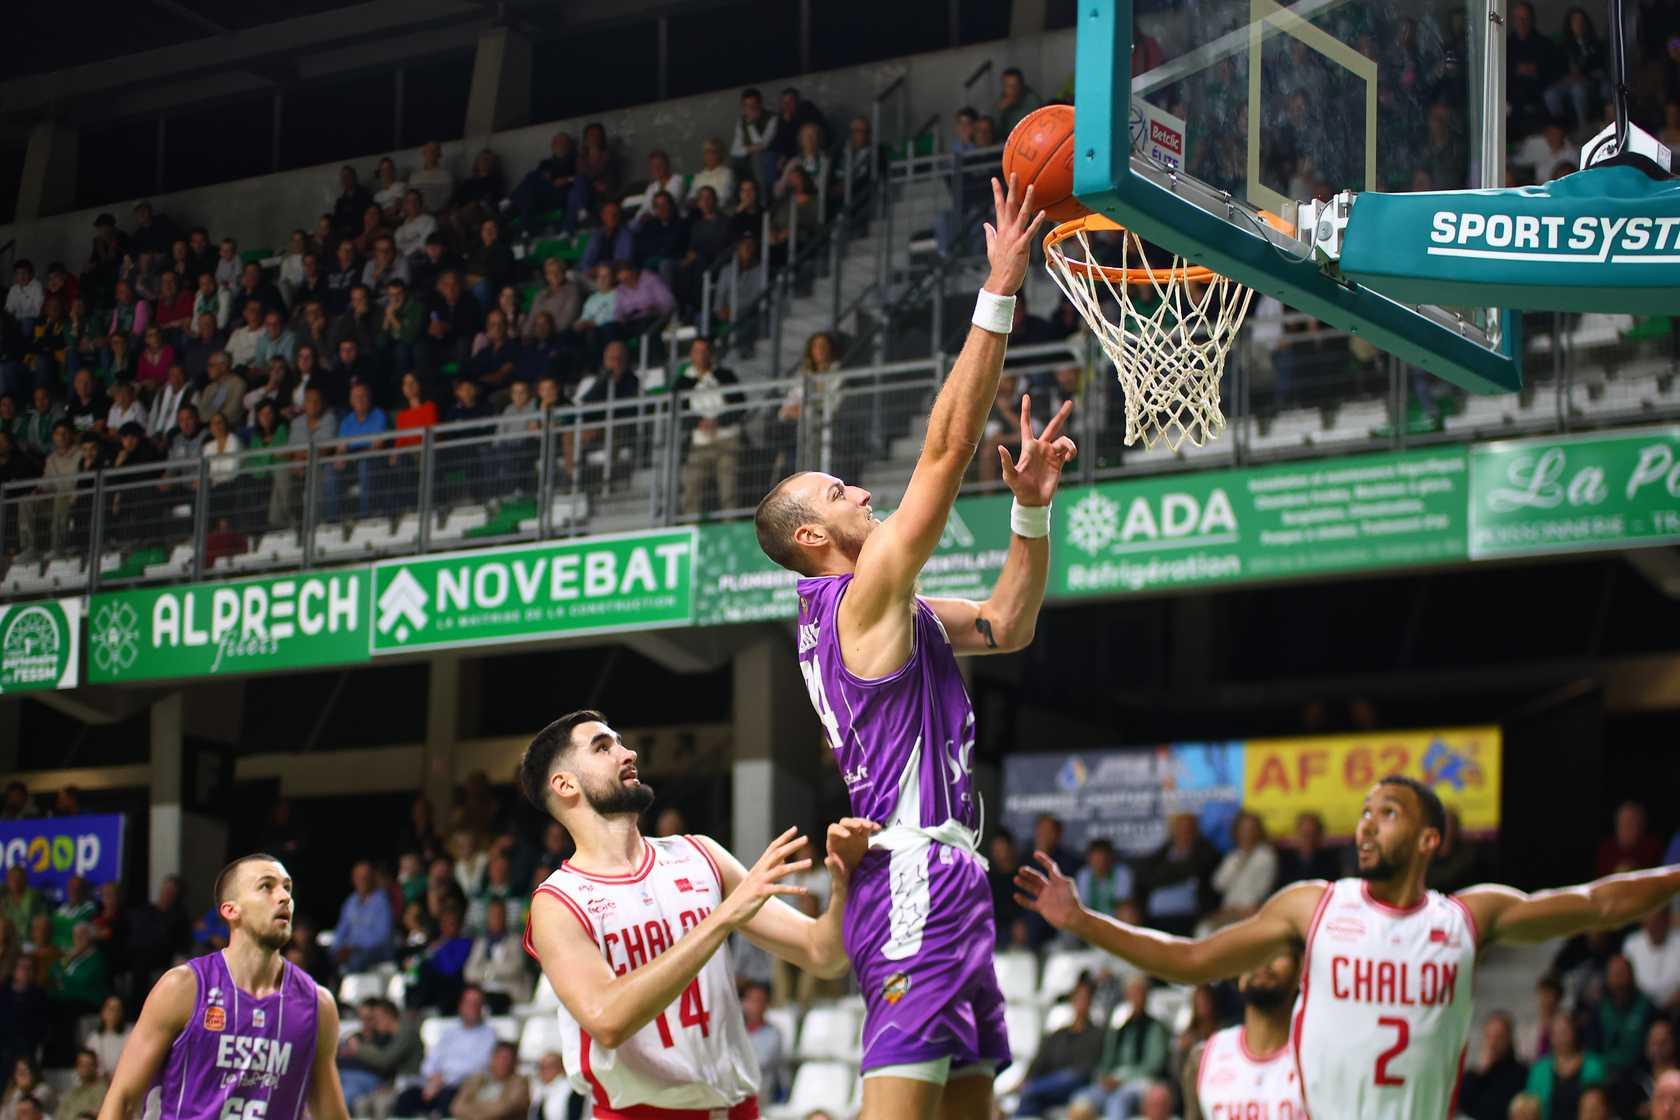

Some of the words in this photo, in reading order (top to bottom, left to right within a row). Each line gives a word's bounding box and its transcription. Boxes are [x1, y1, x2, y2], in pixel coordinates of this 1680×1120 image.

[1152, 125, 1179, 150] Betclic
[1430, 211, 1565, 249] SPORT
[1568, 216, 1680, 263] SYST
[1487, 446, 1608, 513] La
[1120, 489, 1238, 542] ADA
[436, 542, 690, 613] NOVEBAT
[1066, 554, 1241, 591] Réfrigération
[152, 575, 360, 648] ALPRECH
[1254, 749, 1330, 796] AF
[1343, 743, 1410, 790] 62
[0, 832, 101, 877] coop
[603, 906, 712, 978] CHALO
[1331, 955, 1458, 1007] CHALON
[216, 1034, 293, 1076] ESSM
[1374, 1015, 1410, 1086] 2
